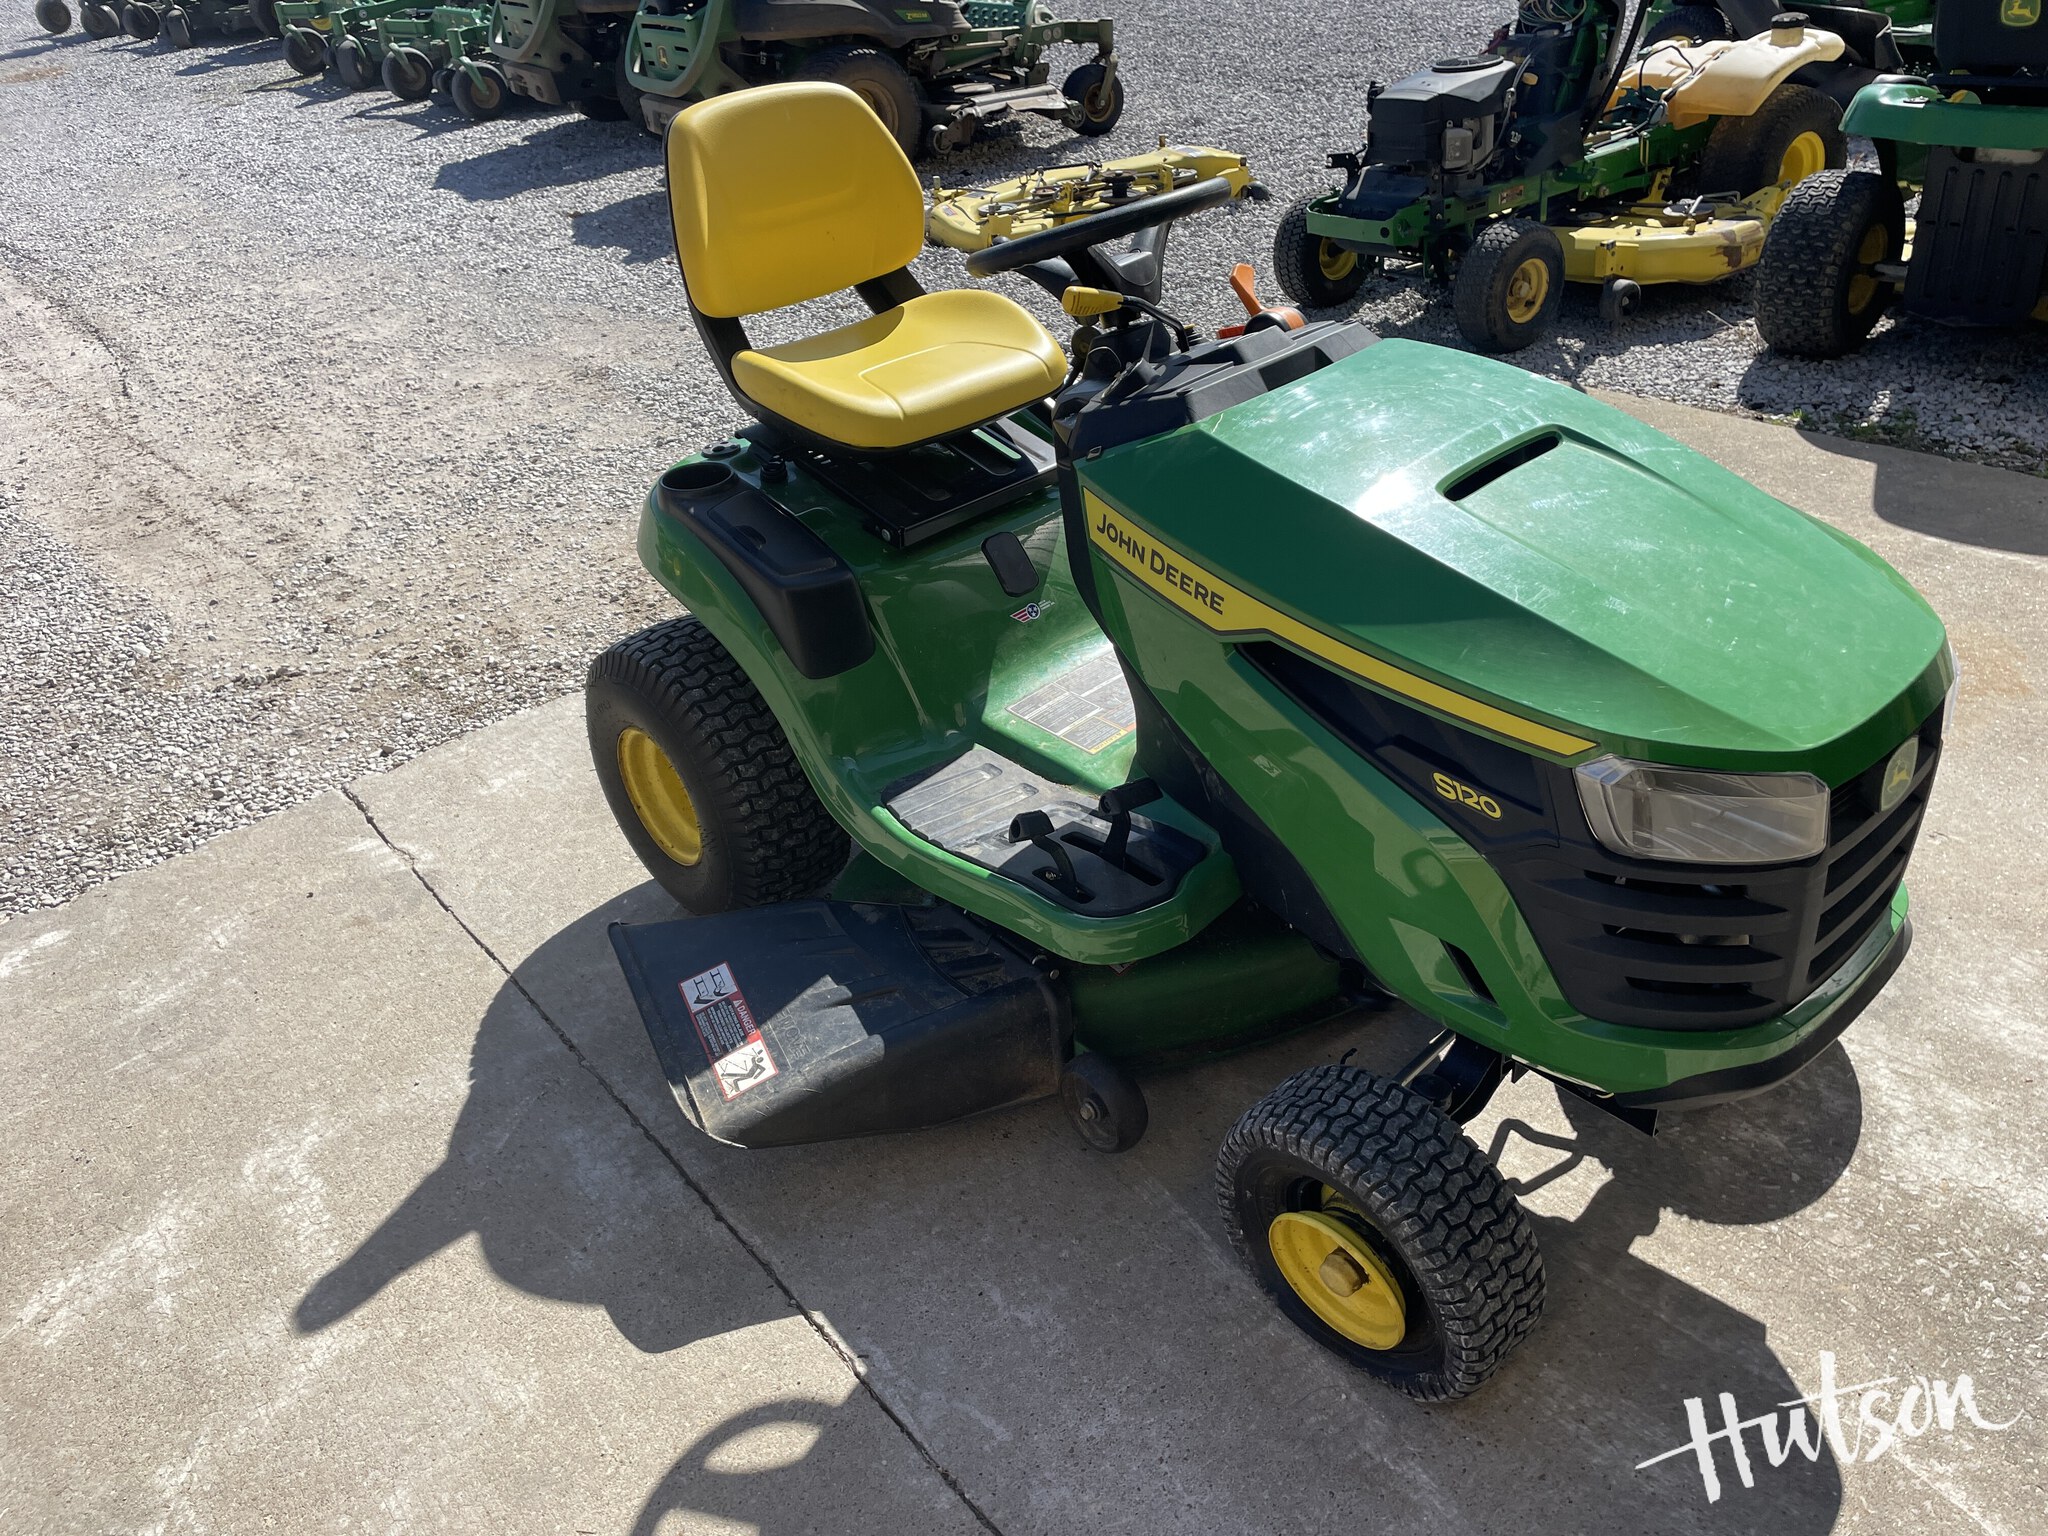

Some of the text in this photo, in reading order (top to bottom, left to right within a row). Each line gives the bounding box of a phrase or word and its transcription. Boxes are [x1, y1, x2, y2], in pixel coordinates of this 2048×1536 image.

[1096, 513, 1225, 616] JOHN DEERE
[1432, 771, 1502, 819] S120
[736, 1004, 756, 1036] DANGER
[774, 1006, 812, 1060] EMOVE
